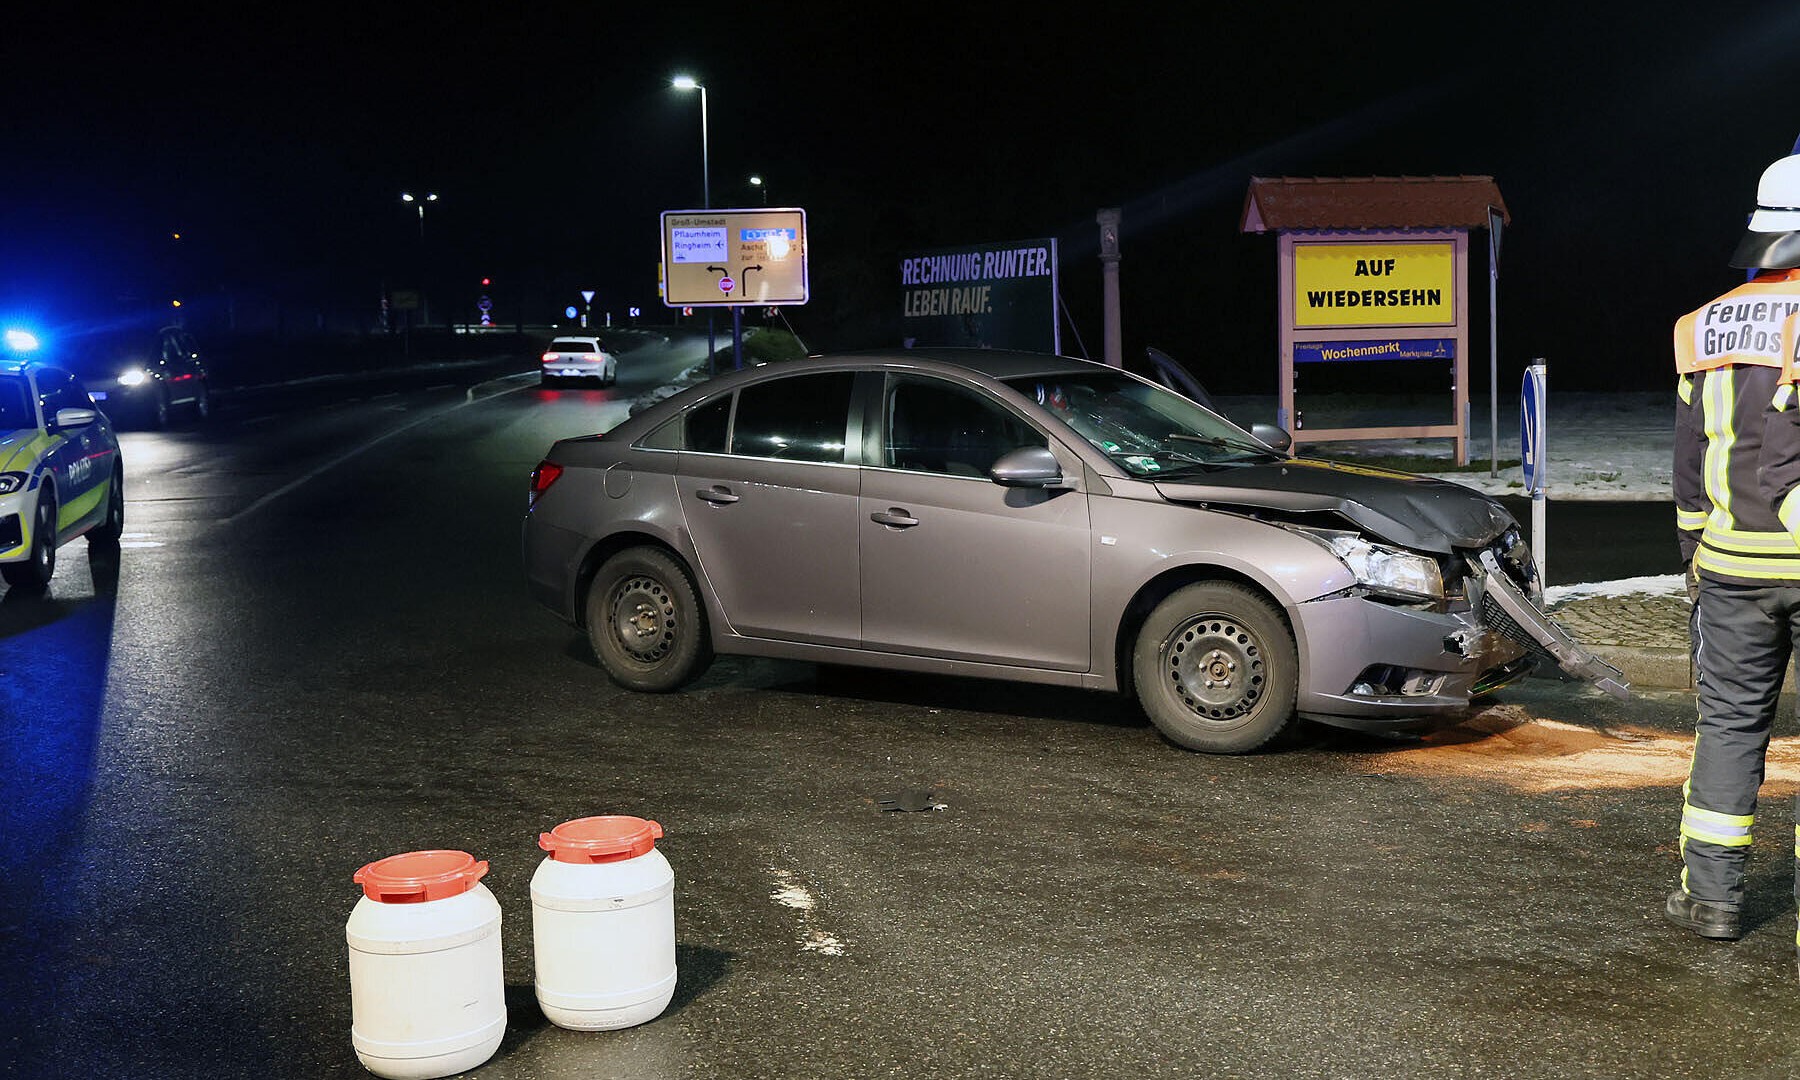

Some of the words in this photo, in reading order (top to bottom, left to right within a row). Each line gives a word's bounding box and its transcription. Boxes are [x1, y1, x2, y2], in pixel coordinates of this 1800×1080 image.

[674, 243, 711, 251] Ringheim
[902, 252, 981, 285] RECHNUNG
[983, 247, 1051, 279] RUNTER.
[1354, 258, 1395, 276] AUF
[904, 288, 949, 317] LEBEN
[951, 285, 993, 315] RAUF.
[1307, 289, 1441, 308] WIEDERSEHN
[1321, 341, 1400, 361] Wochenmarkt
